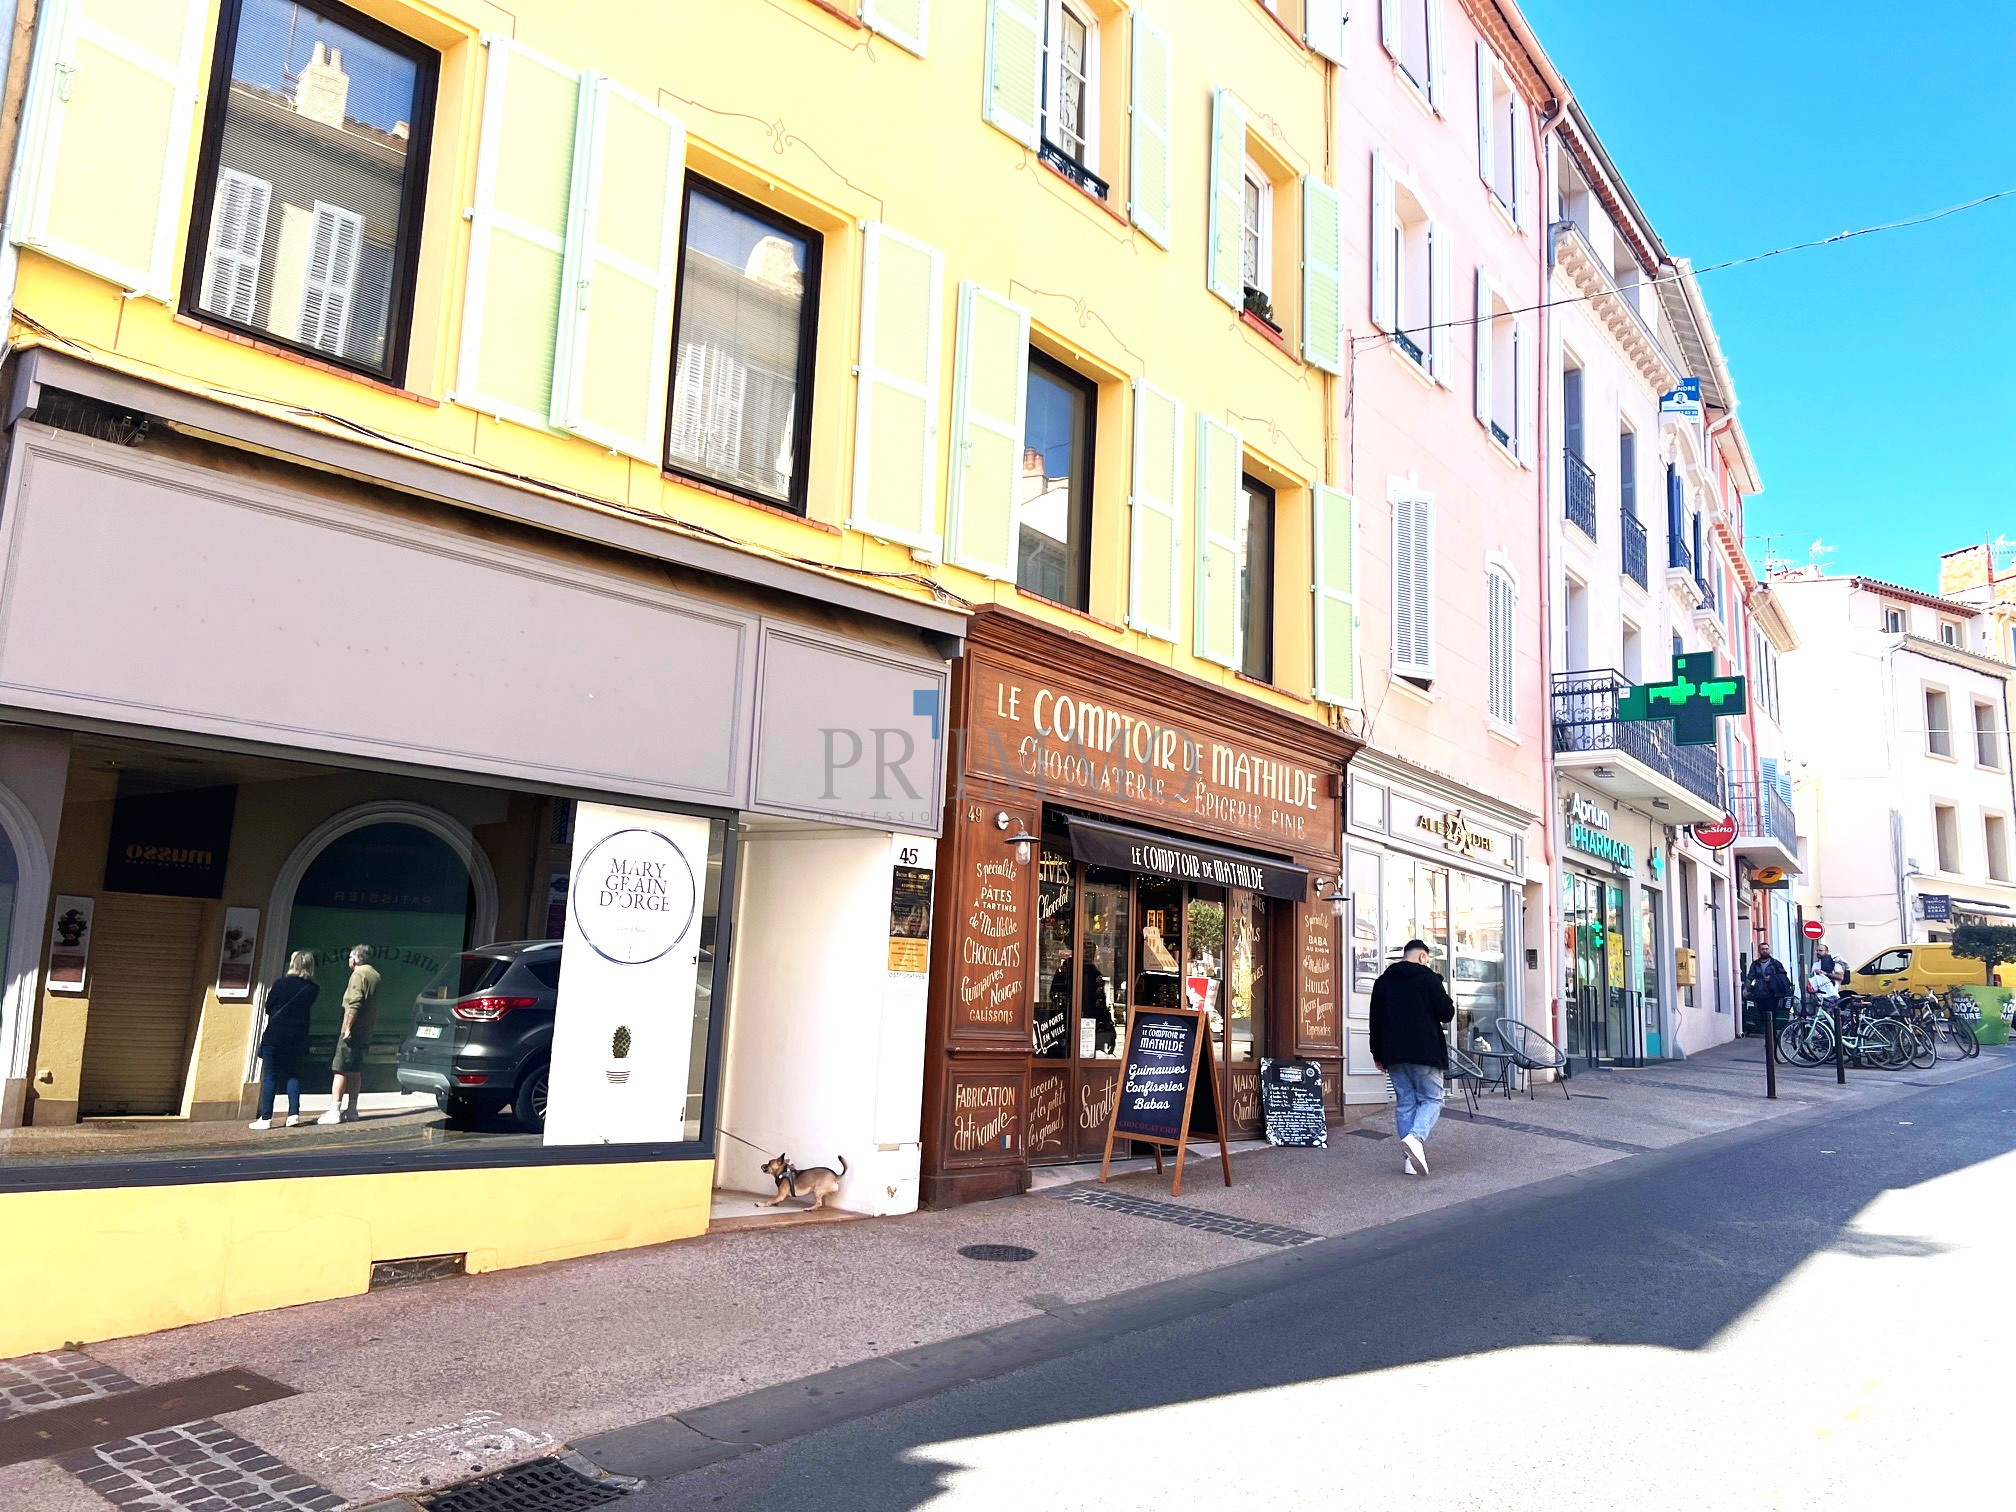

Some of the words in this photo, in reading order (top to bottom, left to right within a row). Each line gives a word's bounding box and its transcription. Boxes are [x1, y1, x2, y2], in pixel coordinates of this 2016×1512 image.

[997, 682, 1022, 721] LE
[1033, 688, 1177, 773] COMPTOIR
[1184, 738, 1204, 775] DE
[1212, 742, 1318, 811] MATHILDE
[967, 805, 983, 823] 49
[1571, 792, 1611, 831] Aprium
[899, 847, 919, 865] 45
[1573, 822, 1636, 871] PHARMACIE
[610, 858, 667, 879] MARY
[976, 858, 1018, 885] Spécialité
[1131, 846, 1141, 866] LE
[1143, 845, 1200, 878] COMPTOIR
[1202, 861, 1214, 879] DE
[1213, 859, 1264, 890] MATHILDE
[605, 874, 668, 896] GRAIN
[981, 884, 1012, 903] PÂTES
[599, 890, 671, 912] D'ORGE
[982, 901, 1017, 912] TARTINER
[969, 912, 979, 930] de
[979, 910, 1018, 938] Mathilde
[963, 936, 1020, 967] CHOCOLATS
[1308, 934, 1328, 947] BABA
[961, 968, 1004, 1006] Guimauves
[990, 980, 1023, 1008] NOUGATS
[1304, 976, 1330, 995] HUILES
[1953, 1002, 1980, 1013] 00%
[1041, 1021, 1048, 1032] ON
[1049, 1012, 1064, 1028] PORTE
[1043, 1033, 1050, 1044] EN
[1050, 1024, 1065, 1038] VILLE
[1140, 1037, 1185, 1052] MATHILDE
[1148, 1029, 1179, 1040] COMPTOIR
[1128, 1063, 1188, 1081] Guimauves
[955, 1083, 1016, 1112] FABRICATION
[1030, 1075, 1058, 1099] uceurs
[1125, 1080, 1185, 1097] Confiseries
[1037, 1095, 1046, 1119] les
[1046, 1080, 1066, 1122] petits
[1133, 1097, 1171, 1110] Babas
[954, 1107, 1018, 1151] Artisanale
[1036, 1107, 1065, 1152] grands
